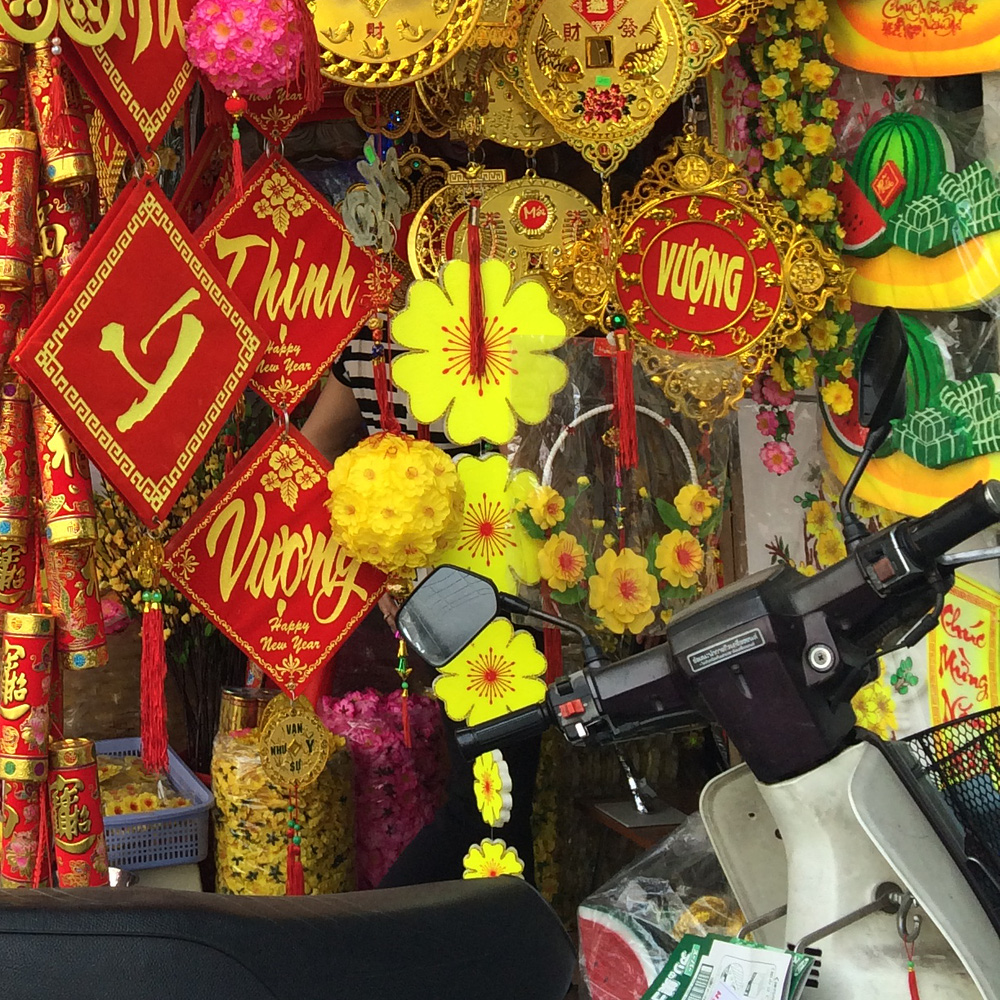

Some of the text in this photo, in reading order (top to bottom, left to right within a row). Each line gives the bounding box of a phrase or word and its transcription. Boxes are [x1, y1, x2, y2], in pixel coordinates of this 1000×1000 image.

[366, 21, 386, 40] 財
[563, 22, 582, 42] 財
[617, 17, 638, 38] 發
[656, 236, 745, 316] VƯỢNG
[266, 339, 302, 357] Happy
[99, 287, 204, 433] Ý
[255, 358, 312, 374] New Year
[268, 616, 310, 633] Happy
[940, 603, 986, 648] Chúc
[260, 636, 321, 652] New Year
[939, 643, 989, 702] Mừng
